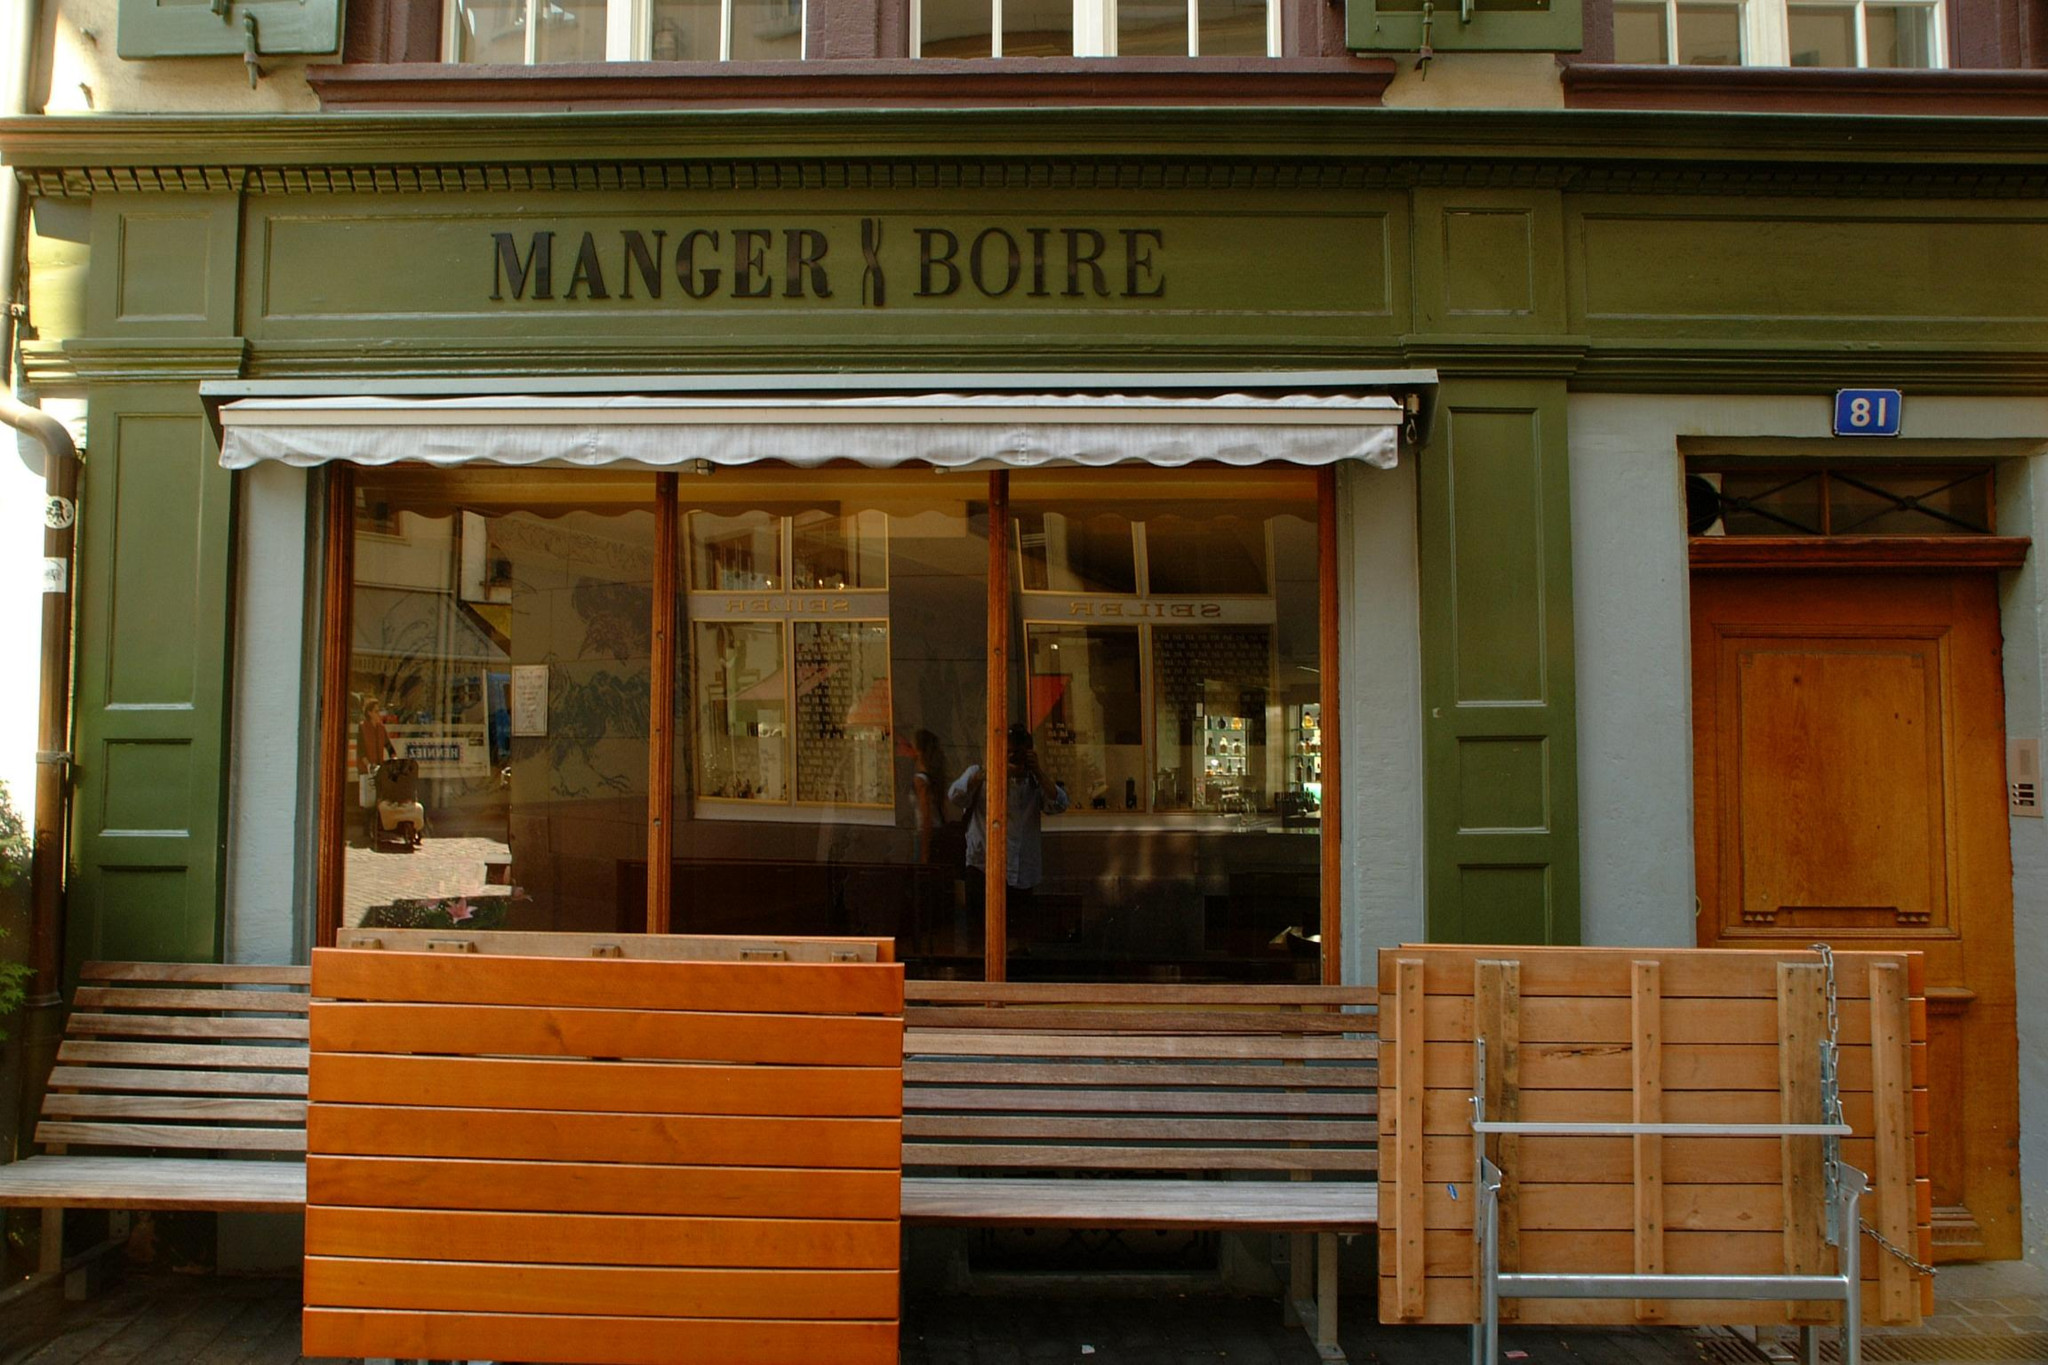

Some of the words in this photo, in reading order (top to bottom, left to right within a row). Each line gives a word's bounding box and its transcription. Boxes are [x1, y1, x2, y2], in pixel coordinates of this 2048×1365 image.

[489, 229, 832, 299] MANGER
[913, 227, 1166, 297] BOIRE
[1850, 397, 1886, 427] 81
